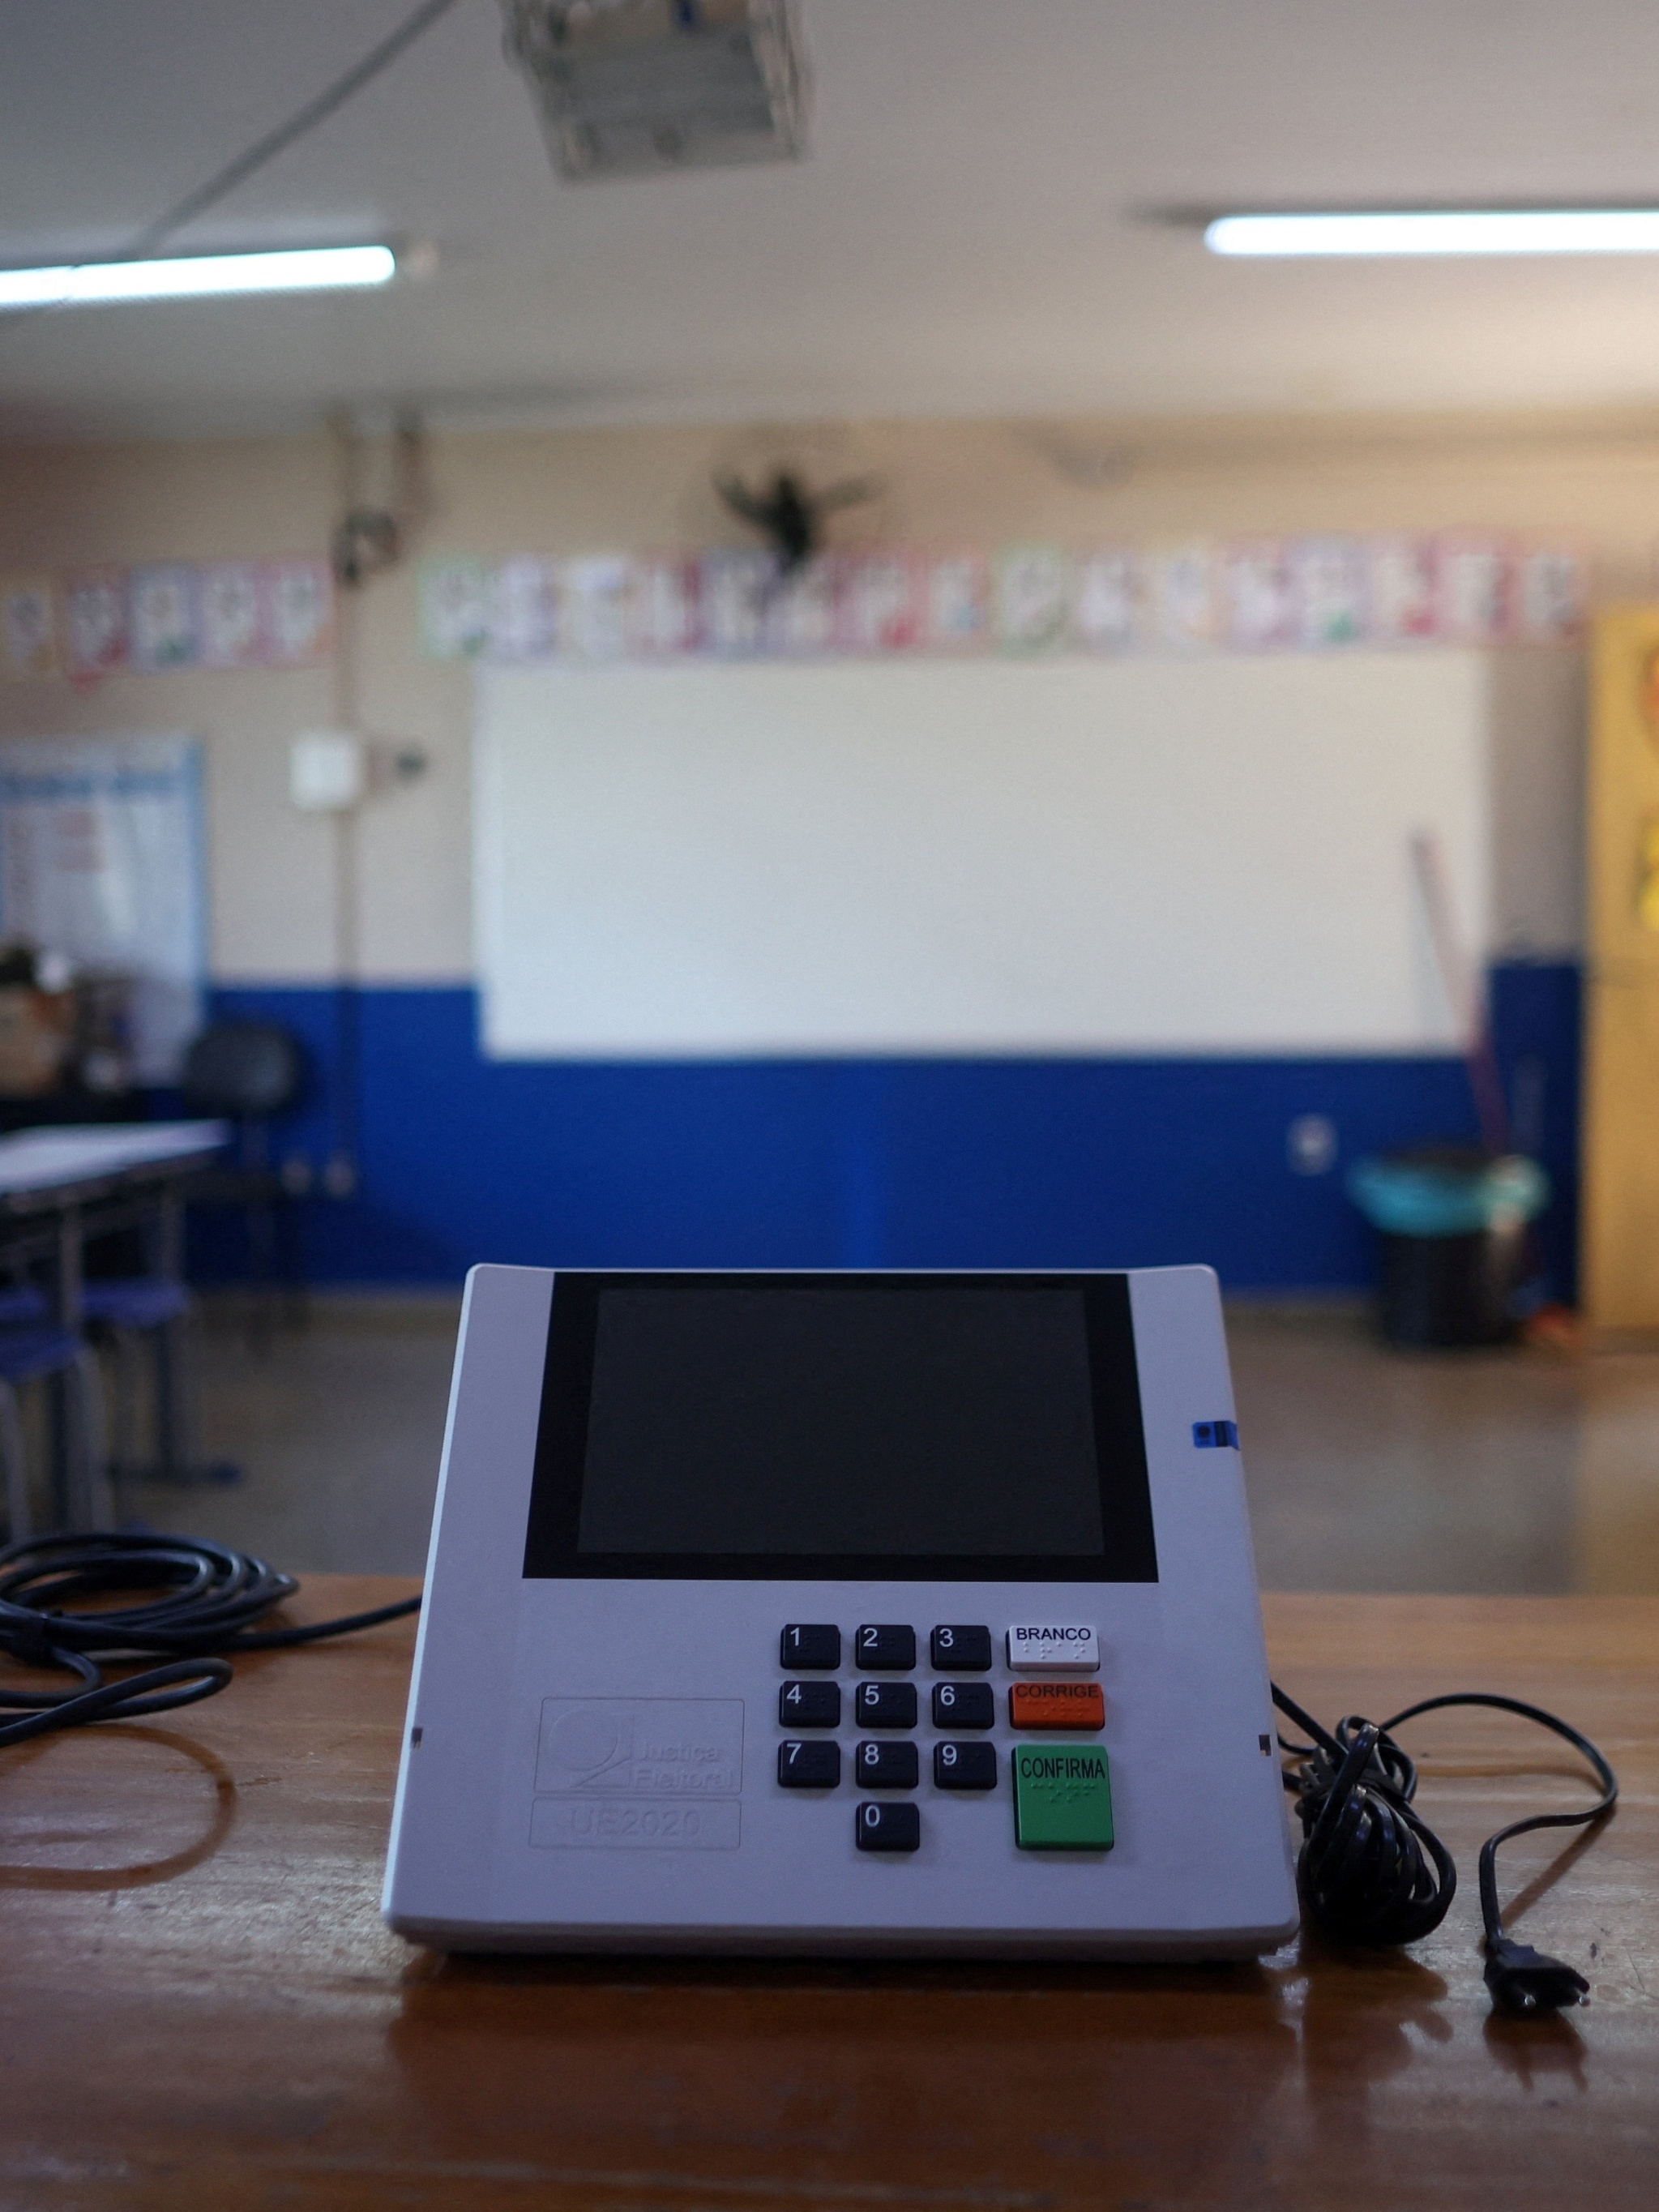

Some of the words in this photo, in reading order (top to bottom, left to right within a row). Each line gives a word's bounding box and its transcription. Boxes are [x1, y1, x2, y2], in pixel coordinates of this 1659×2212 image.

[790, 1628, 800, 1646] 1
[863, 1628, 878, 1647] 2
[939, 1628, 954, 1647] 3
[1016, 1628, 1091, 1641] BRANCO
[786, 1684, 802, 1704] 4
[865, 1685, 879, 1705] 5
[940, 1686, 956, 1705] 6
[1016, 1685, 1099, 1698] CORRIGE
[786, 1744, 802, 1764] 7
[865, 1744, 879, 1765] 8
[942, 1744, 957, 1765] 9
[1021, 1757, 1105, 1778] CONFIRMA
[571, 1808, 703, 1837] UE2020
[865, 1805, 880, 1827] 0
